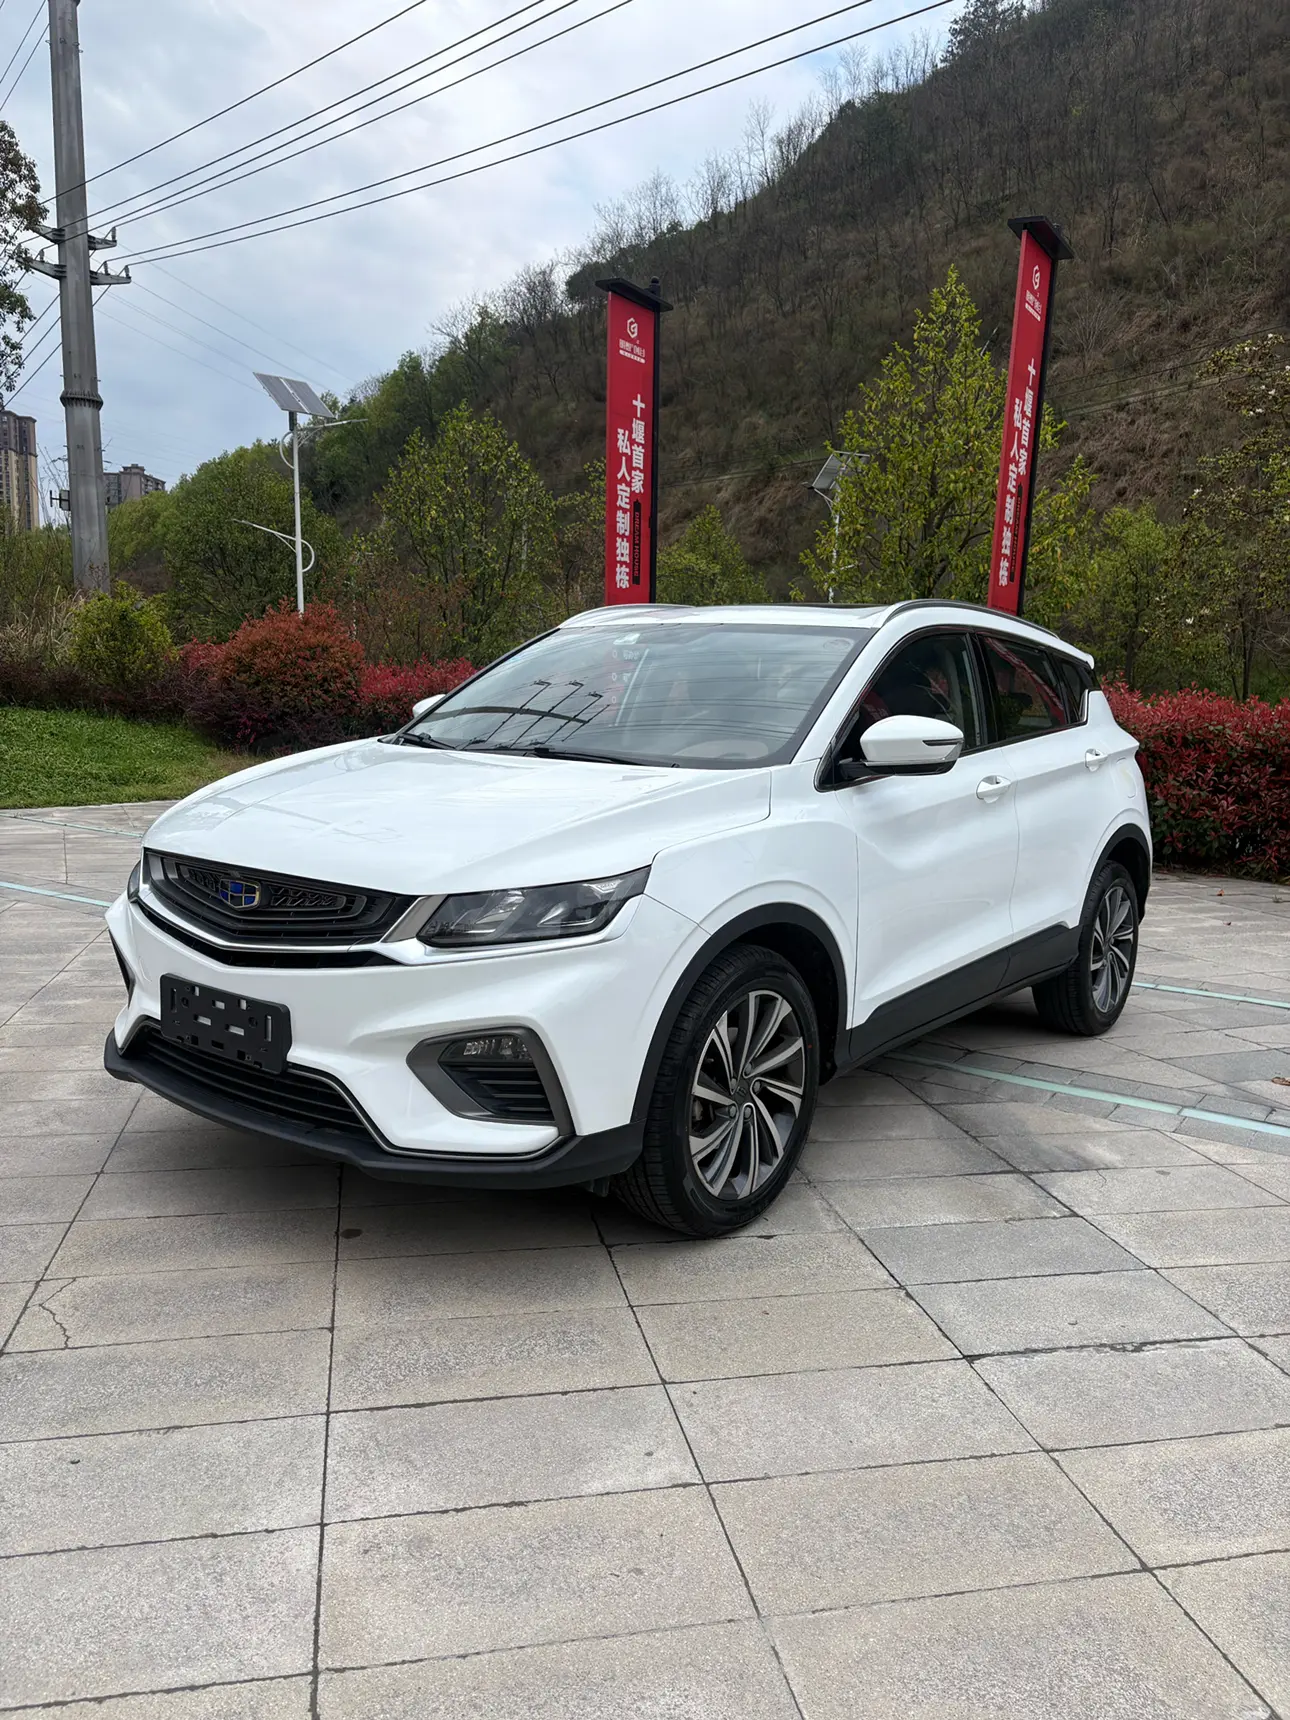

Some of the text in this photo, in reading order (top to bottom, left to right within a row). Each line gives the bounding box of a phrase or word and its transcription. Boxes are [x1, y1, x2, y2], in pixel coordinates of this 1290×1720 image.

[631, 393, 645, 494] 十堰首家
[1018, 358, 1036, 476] 十堰首家
[616, 428, 631, 589] 私人定制独栋
[999, 397, 1023, 586] 私人定制独栋
